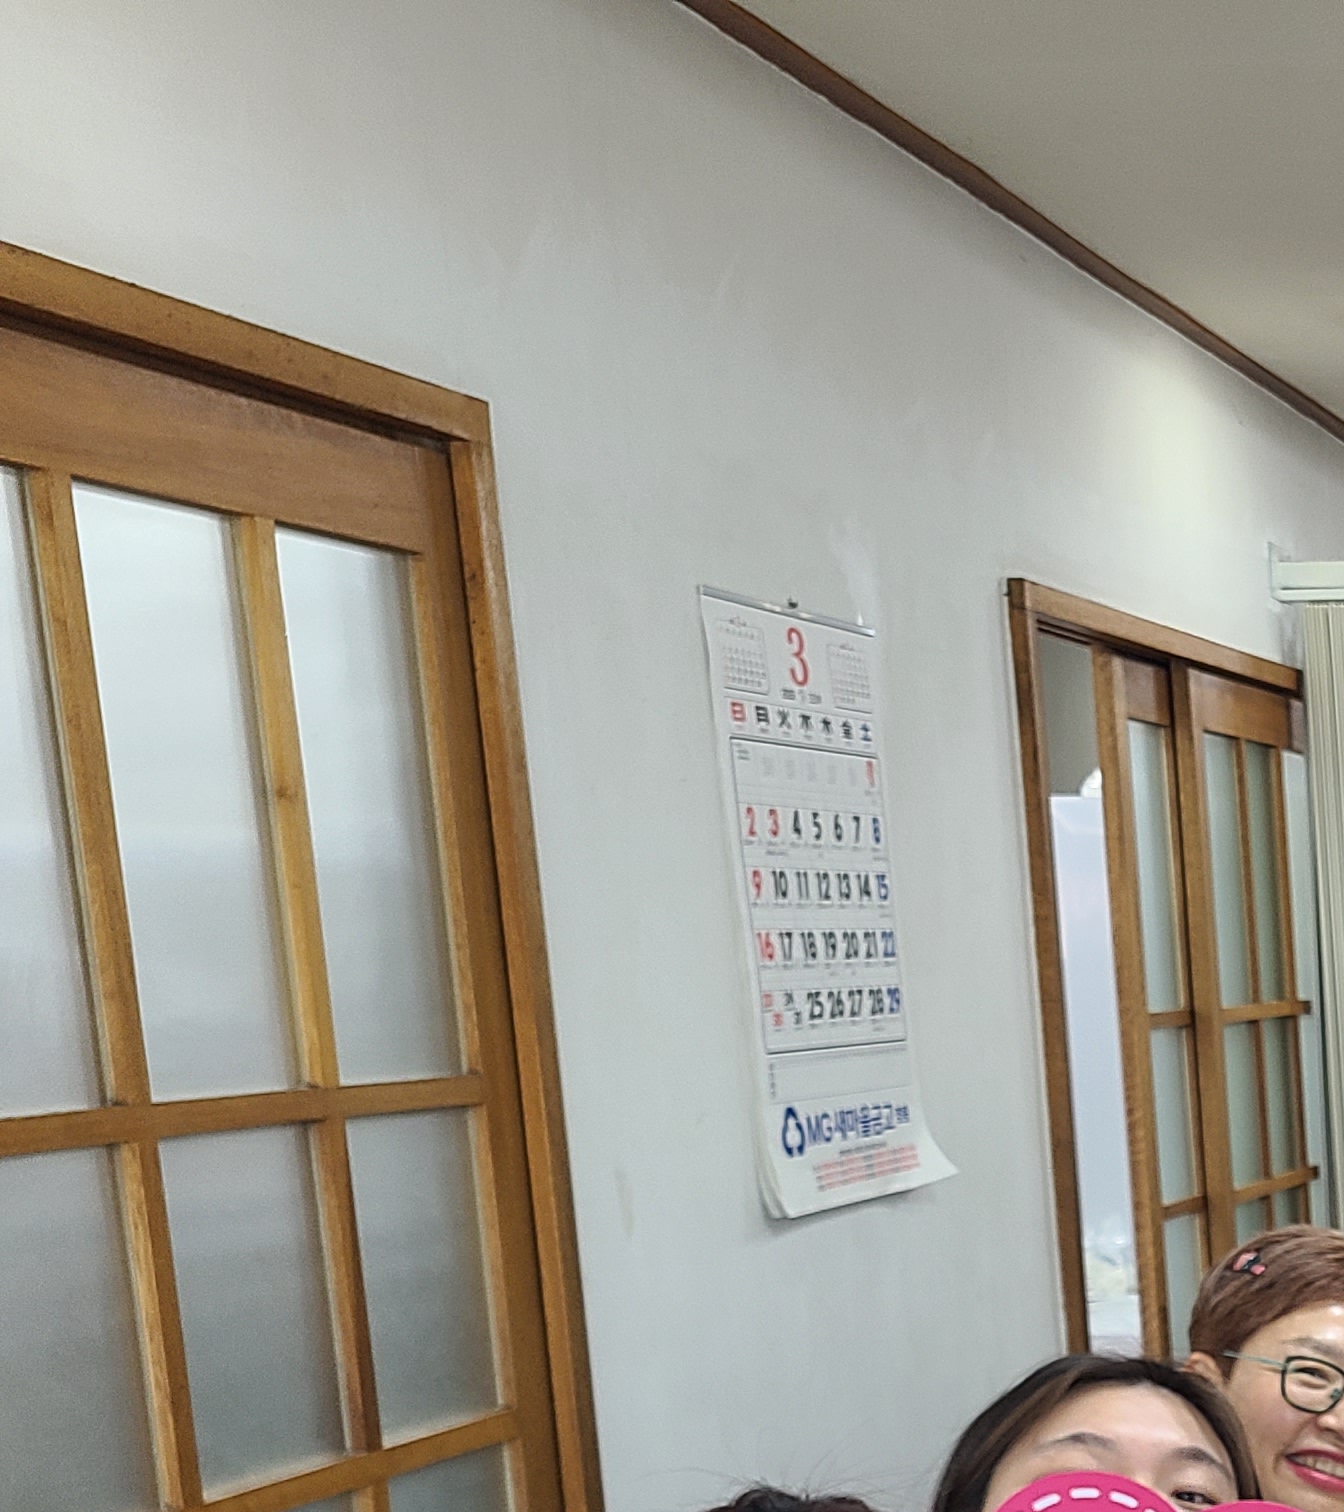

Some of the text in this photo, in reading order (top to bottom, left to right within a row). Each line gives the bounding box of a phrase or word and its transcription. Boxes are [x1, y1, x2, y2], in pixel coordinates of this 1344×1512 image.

[786, 627, 810, 687] 3
[772, 870, 788, 899] 10
[816, 872, 832, 901] 12
